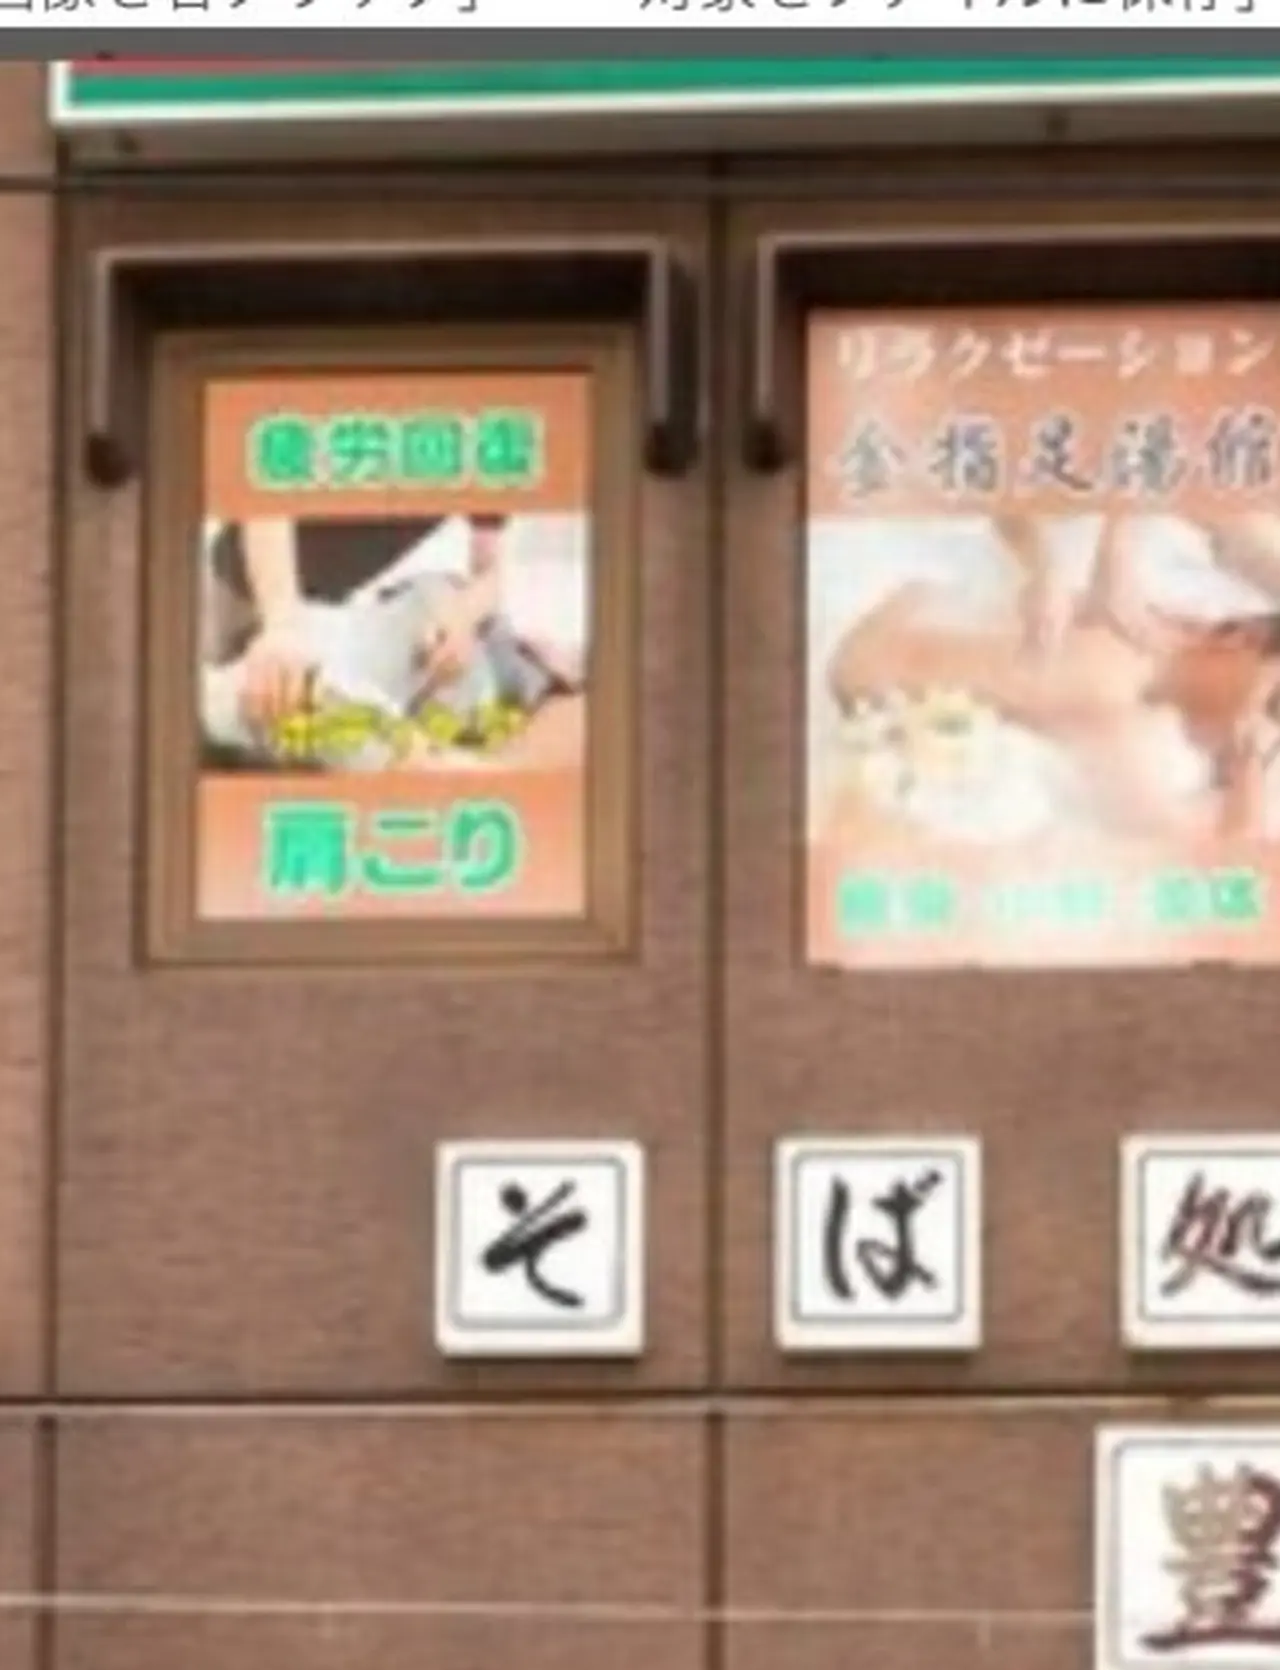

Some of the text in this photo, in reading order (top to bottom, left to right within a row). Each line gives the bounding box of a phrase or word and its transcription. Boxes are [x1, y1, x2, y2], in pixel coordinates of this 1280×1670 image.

[835, 328, 1276, 380] リラクゼーション
[264, 804, 520, 894] 肩こり
